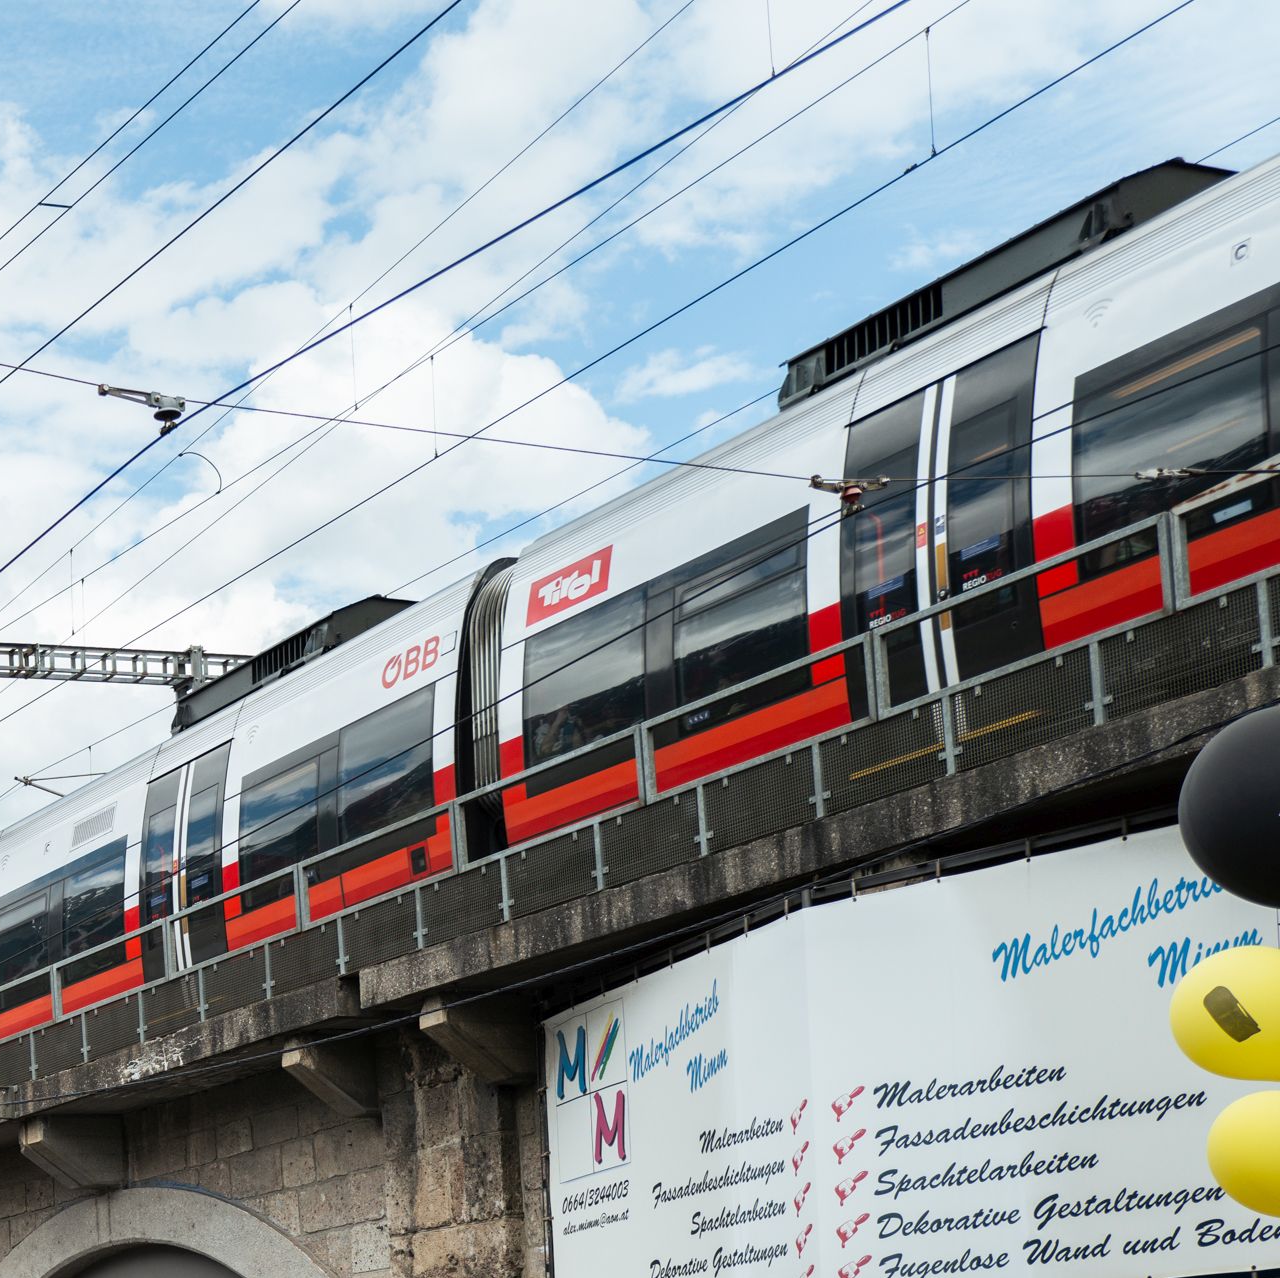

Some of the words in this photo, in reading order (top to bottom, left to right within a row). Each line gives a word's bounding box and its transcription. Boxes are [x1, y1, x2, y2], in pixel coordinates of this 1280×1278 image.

[538, 560, 602, 607] Tirol
[381, 635, 440, 689] ÖBB
[629, 978, 719, 1083] Malerfachbetrieb
[686, 1048, 728, 1094] Mimm
[873, 1064, 1068, 1109] Malerarbeiten
[699, 1116, 783, 1154] Malerarbeiten
[873, 1088, 1208, 1157] Fassadenbeschichtungen
[562, 1179, 630, 1215] 0664/3244003
[652, 1158, 785, 1209] Fassadenbeschichtungen
[873, 1148, 1099, 1200] Spachtelarbeiten
[562, 1208, 630, 1236] alex.mimm@aon.at
[690, 1201, 786, 1238] Spachtelarbeiten
[876, 1204, 1022, 1240] Dekorative
[1033, 1183, 1227, 1230] Gestaltungen
[712, 1243, 788, 1271] Gestaltungen
[1022, 1233, 1112, 1266] Wand
[1123, 1226, 1181, 1260] und
